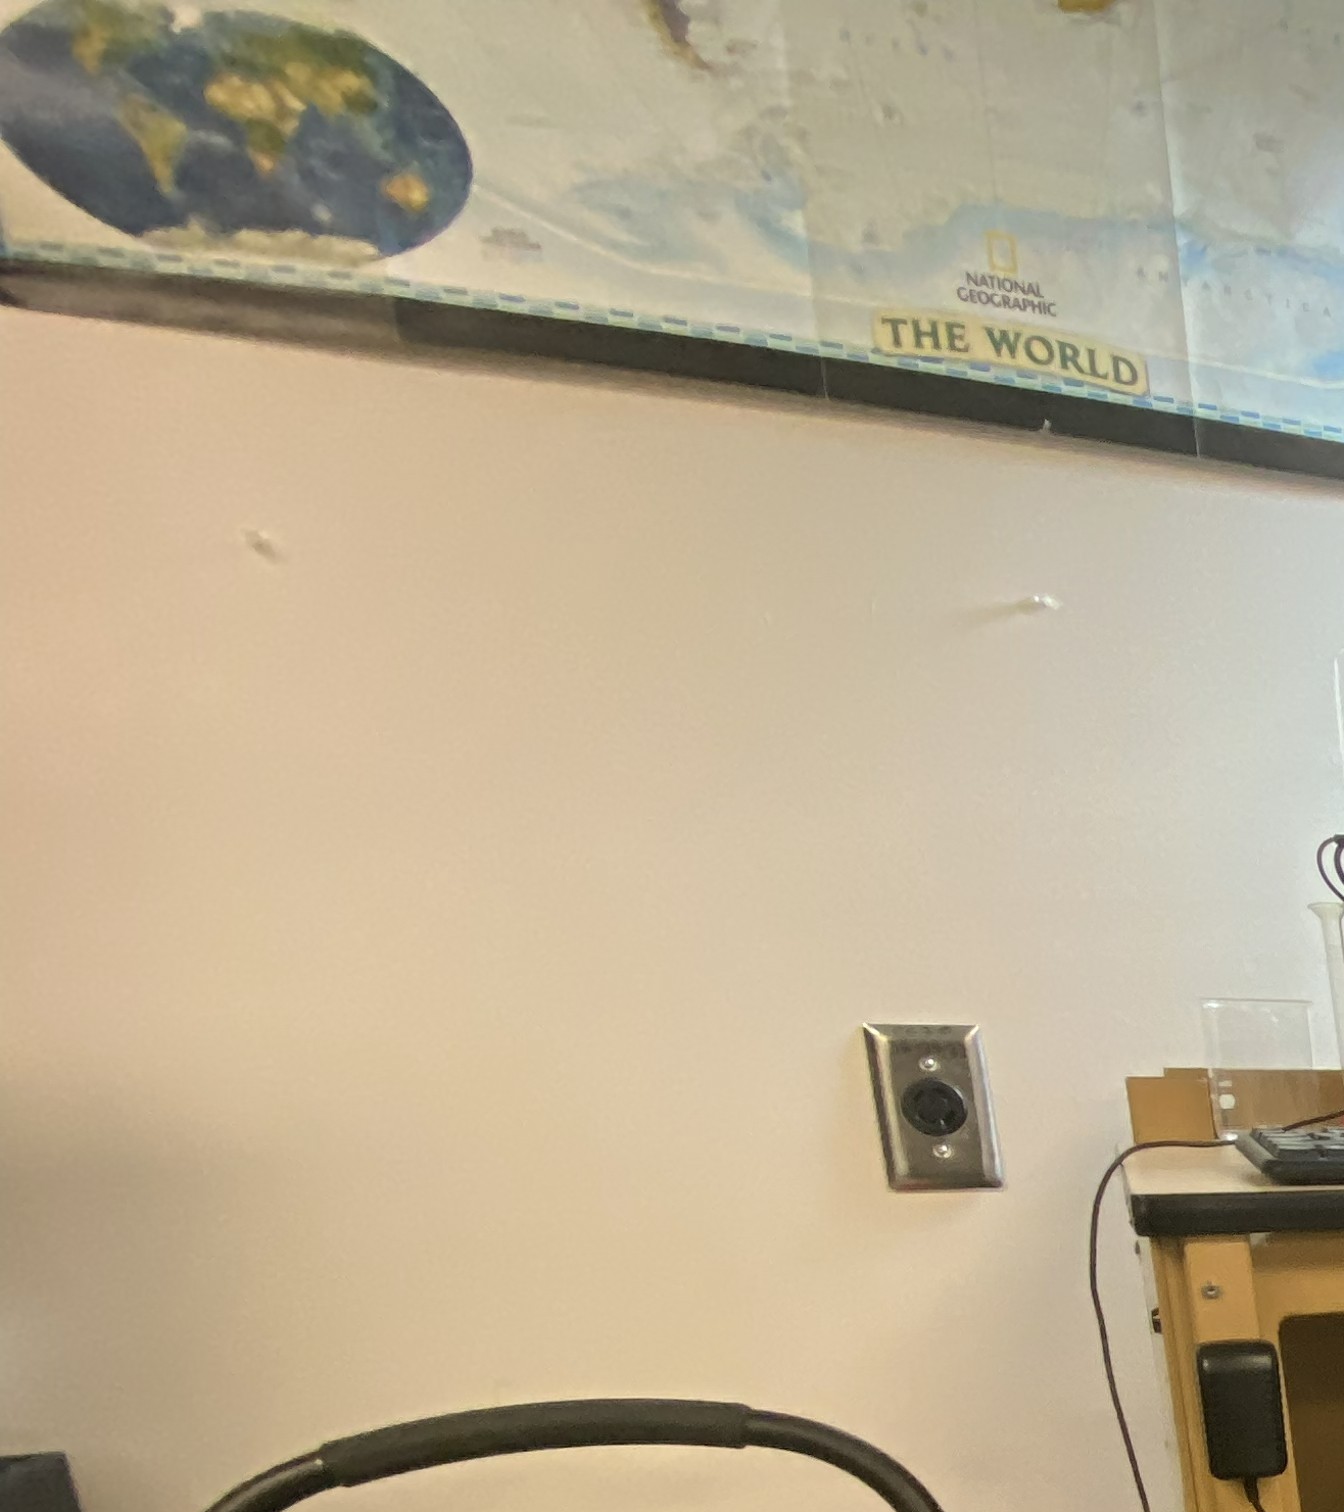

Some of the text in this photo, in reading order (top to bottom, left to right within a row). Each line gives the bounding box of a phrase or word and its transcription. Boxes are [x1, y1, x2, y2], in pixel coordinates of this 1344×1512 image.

[965, 271, 1045, 299] NATIONAL
[956, 286, 1057, 317] GEOGRAPHIC
[881, 317, 1139, 386] THE WORLD
